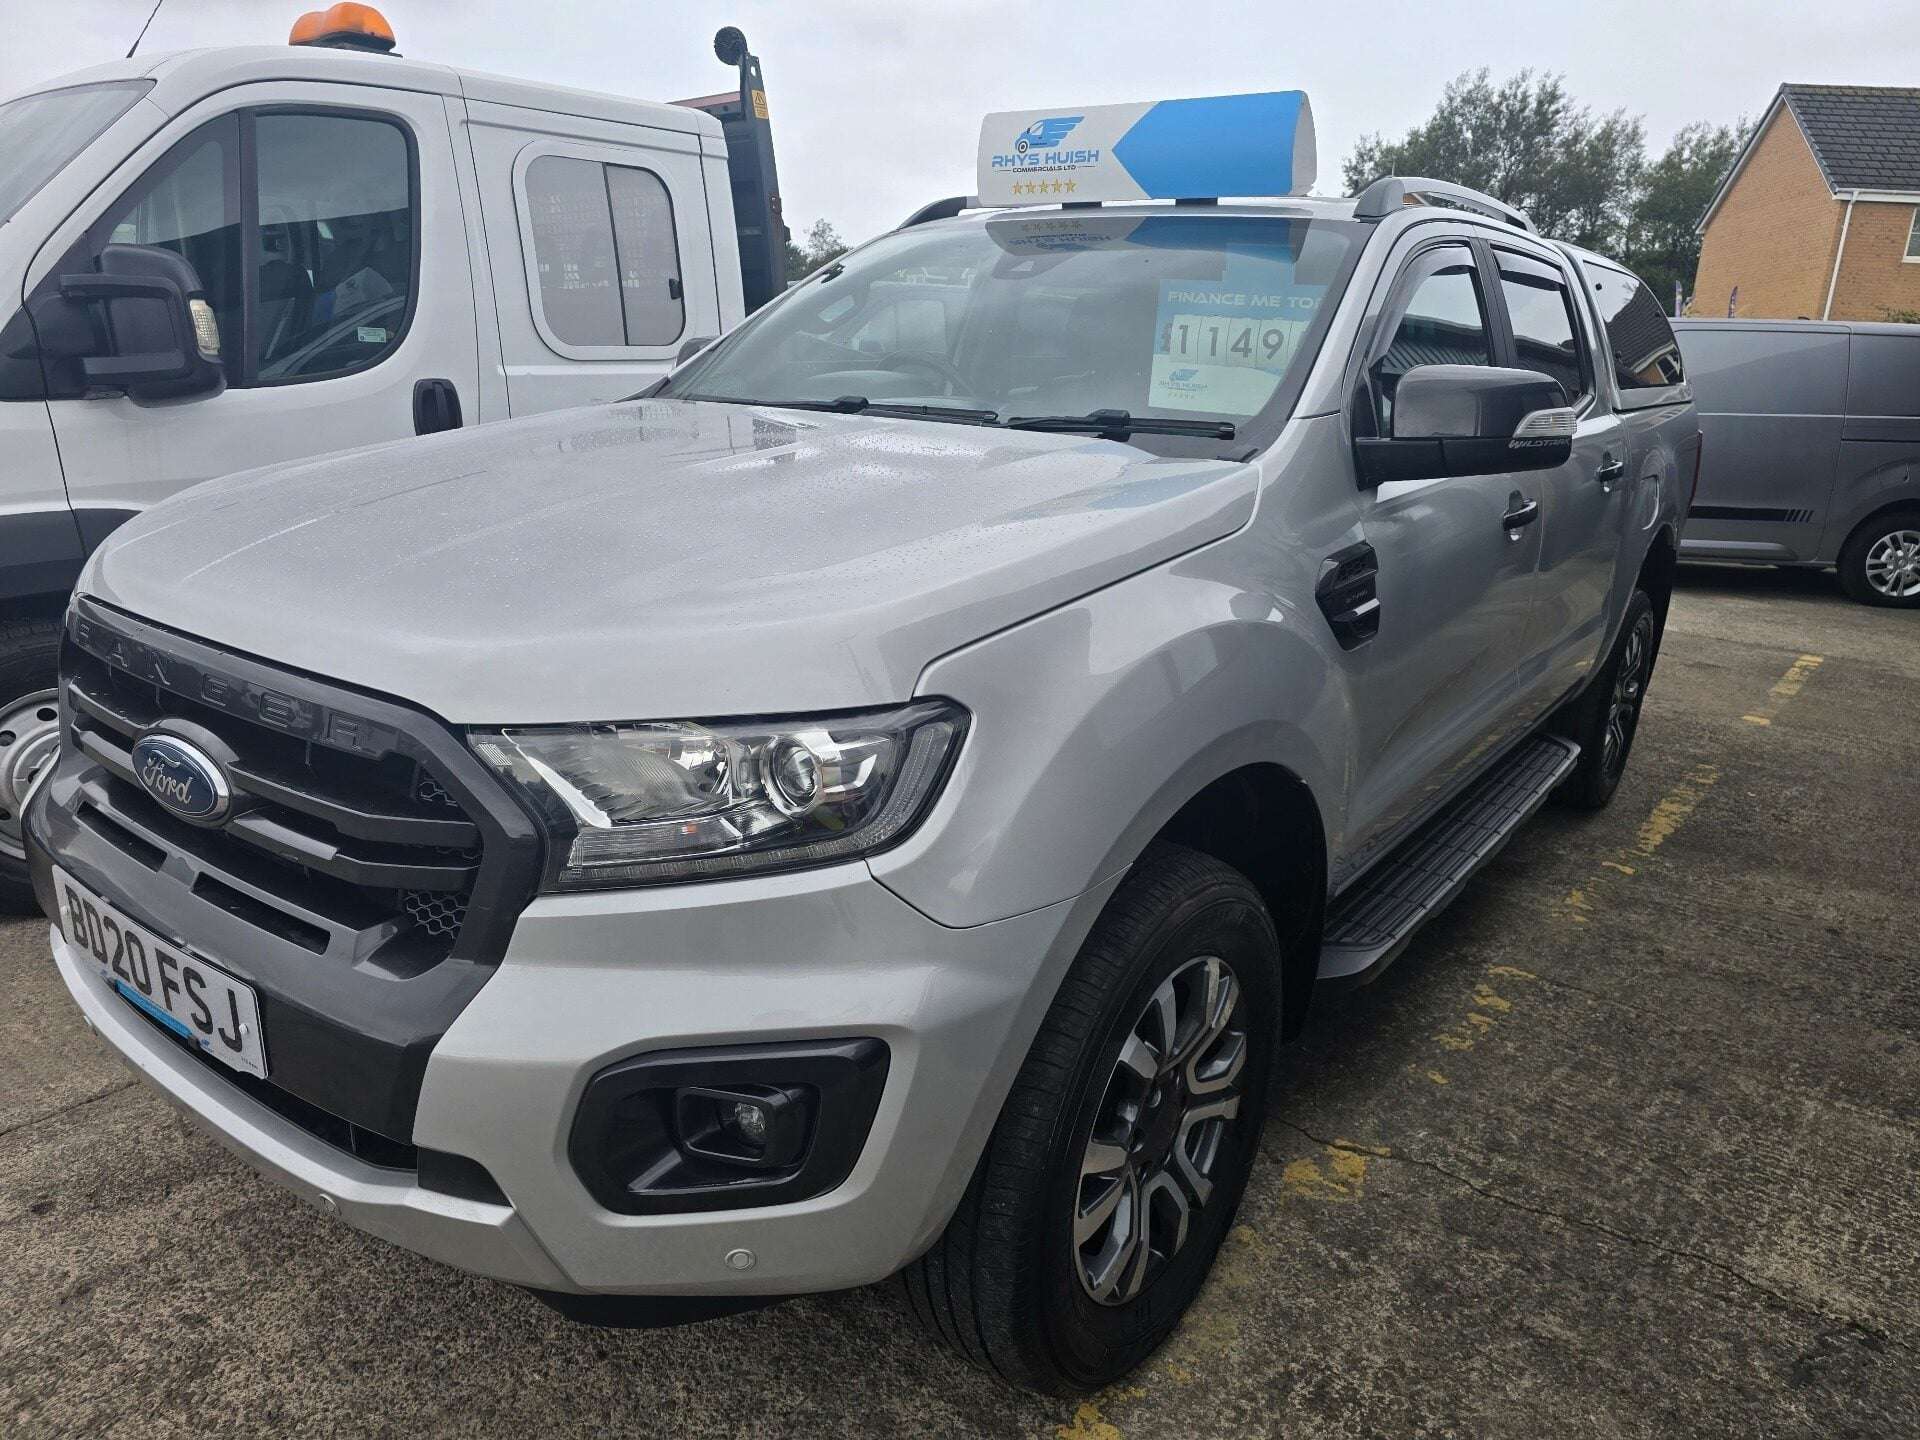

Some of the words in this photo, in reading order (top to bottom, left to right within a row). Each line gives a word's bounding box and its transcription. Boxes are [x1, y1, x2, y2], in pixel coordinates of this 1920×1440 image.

[991, 154, 1039, 168] RHYS
[1045, 150, 1099, 164] HUISH
[1168, 291, 1244, 306] FINANCE
[1251, 295, 1281, 308] ME
[142, 749, 193, 805] Ford
